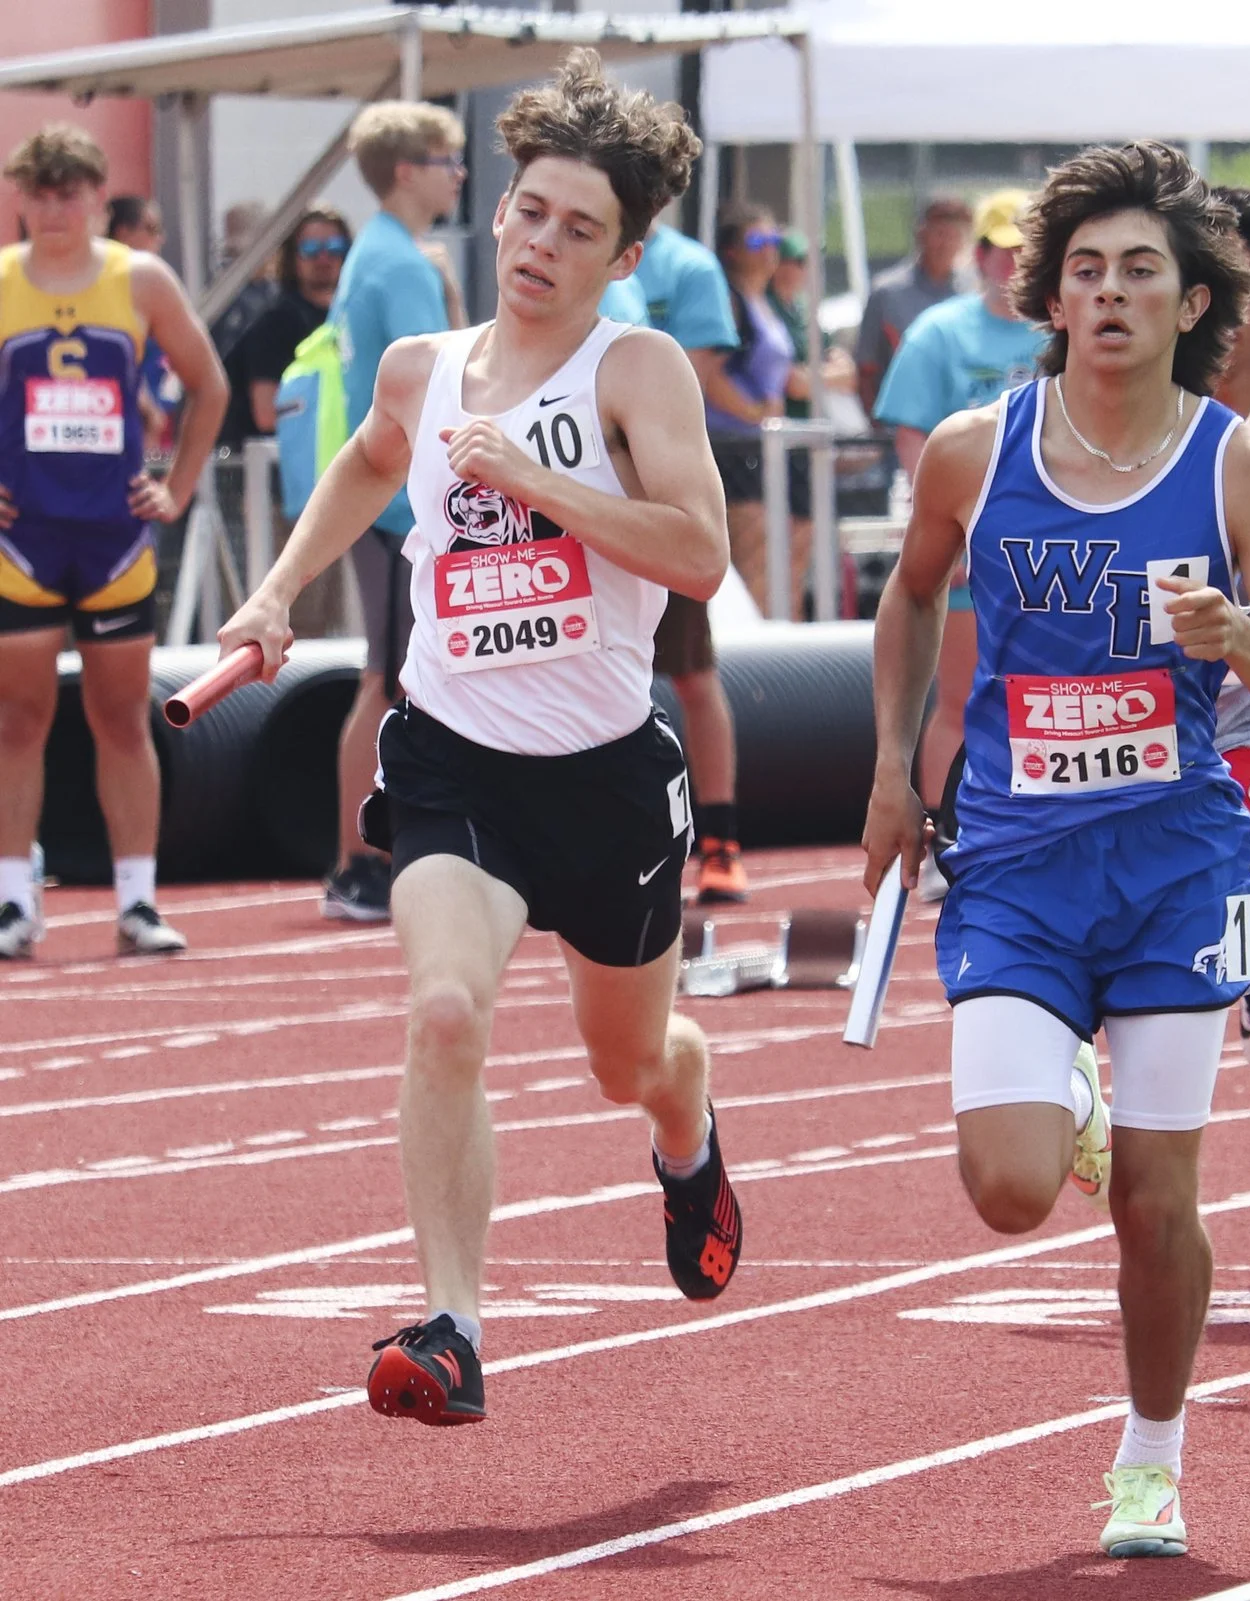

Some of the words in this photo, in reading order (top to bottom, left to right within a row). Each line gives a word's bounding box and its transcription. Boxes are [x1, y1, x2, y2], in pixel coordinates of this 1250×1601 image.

[526, 413, 583, 470] 10
[471, 548, 536, 569] SHOW-ME
[446, 557, 570, 607] ZERO
[473, 617, 558, 657] 2049
[1050, 681, 1123, 695] SHOW-ME
[1023, 689, 1156, 730] ZERO
[1050, 744, 1139, 783] 2116
[677, 776, 688, 824] 1
[1234, 901, 1247, 975] 1
